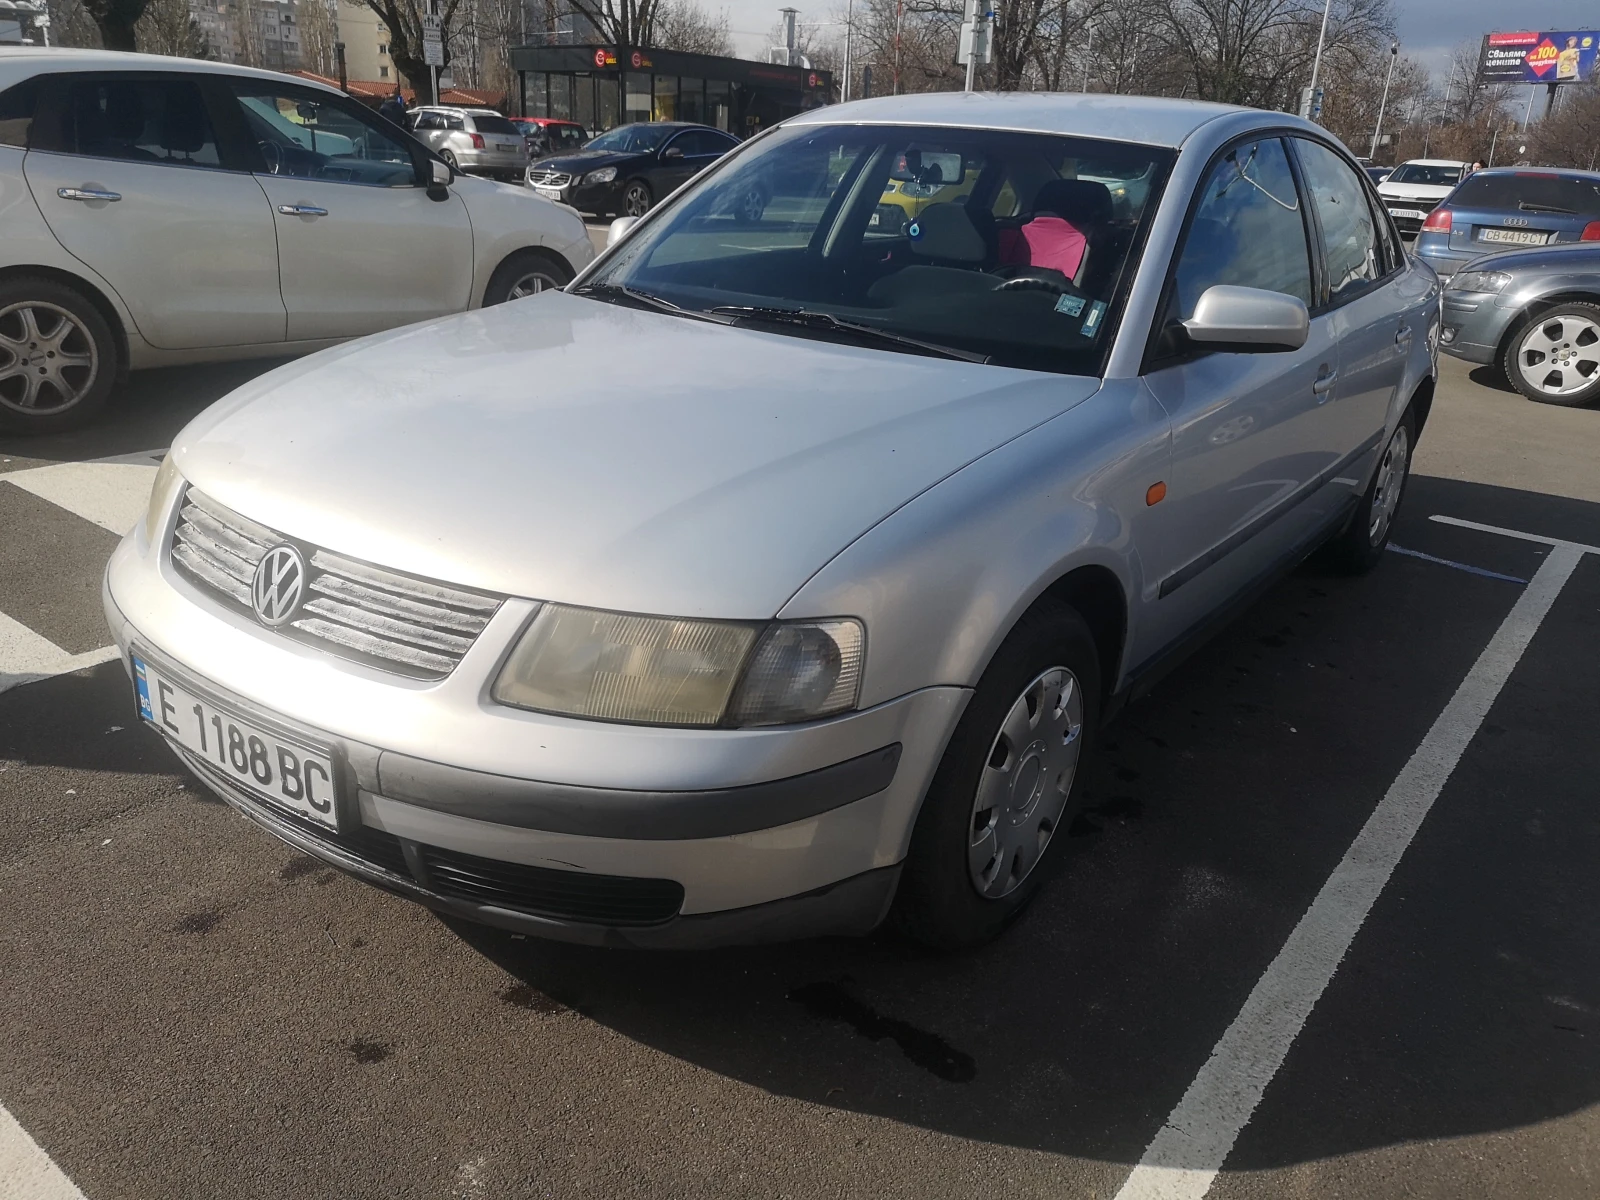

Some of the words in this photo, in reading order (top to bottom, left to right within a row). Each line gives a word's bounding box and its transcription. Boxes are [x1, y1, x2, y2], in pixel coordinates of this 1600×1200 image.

[1488, 50, 1526, 58] Сваляме
[1538, 46, 1558, 59] 100
[1486, 58, 1520, 66] цените
[1486, 230, 1500, 240] CB
[1502, 232, 1528, 243] 4419
[1529, 234, 1543, 244] CT
[140, 694, 151, 712] BG
[158, 678, 179, 734] E
[193, 703, 273, 786] 1188
[276, 744, 331, 814] BC
